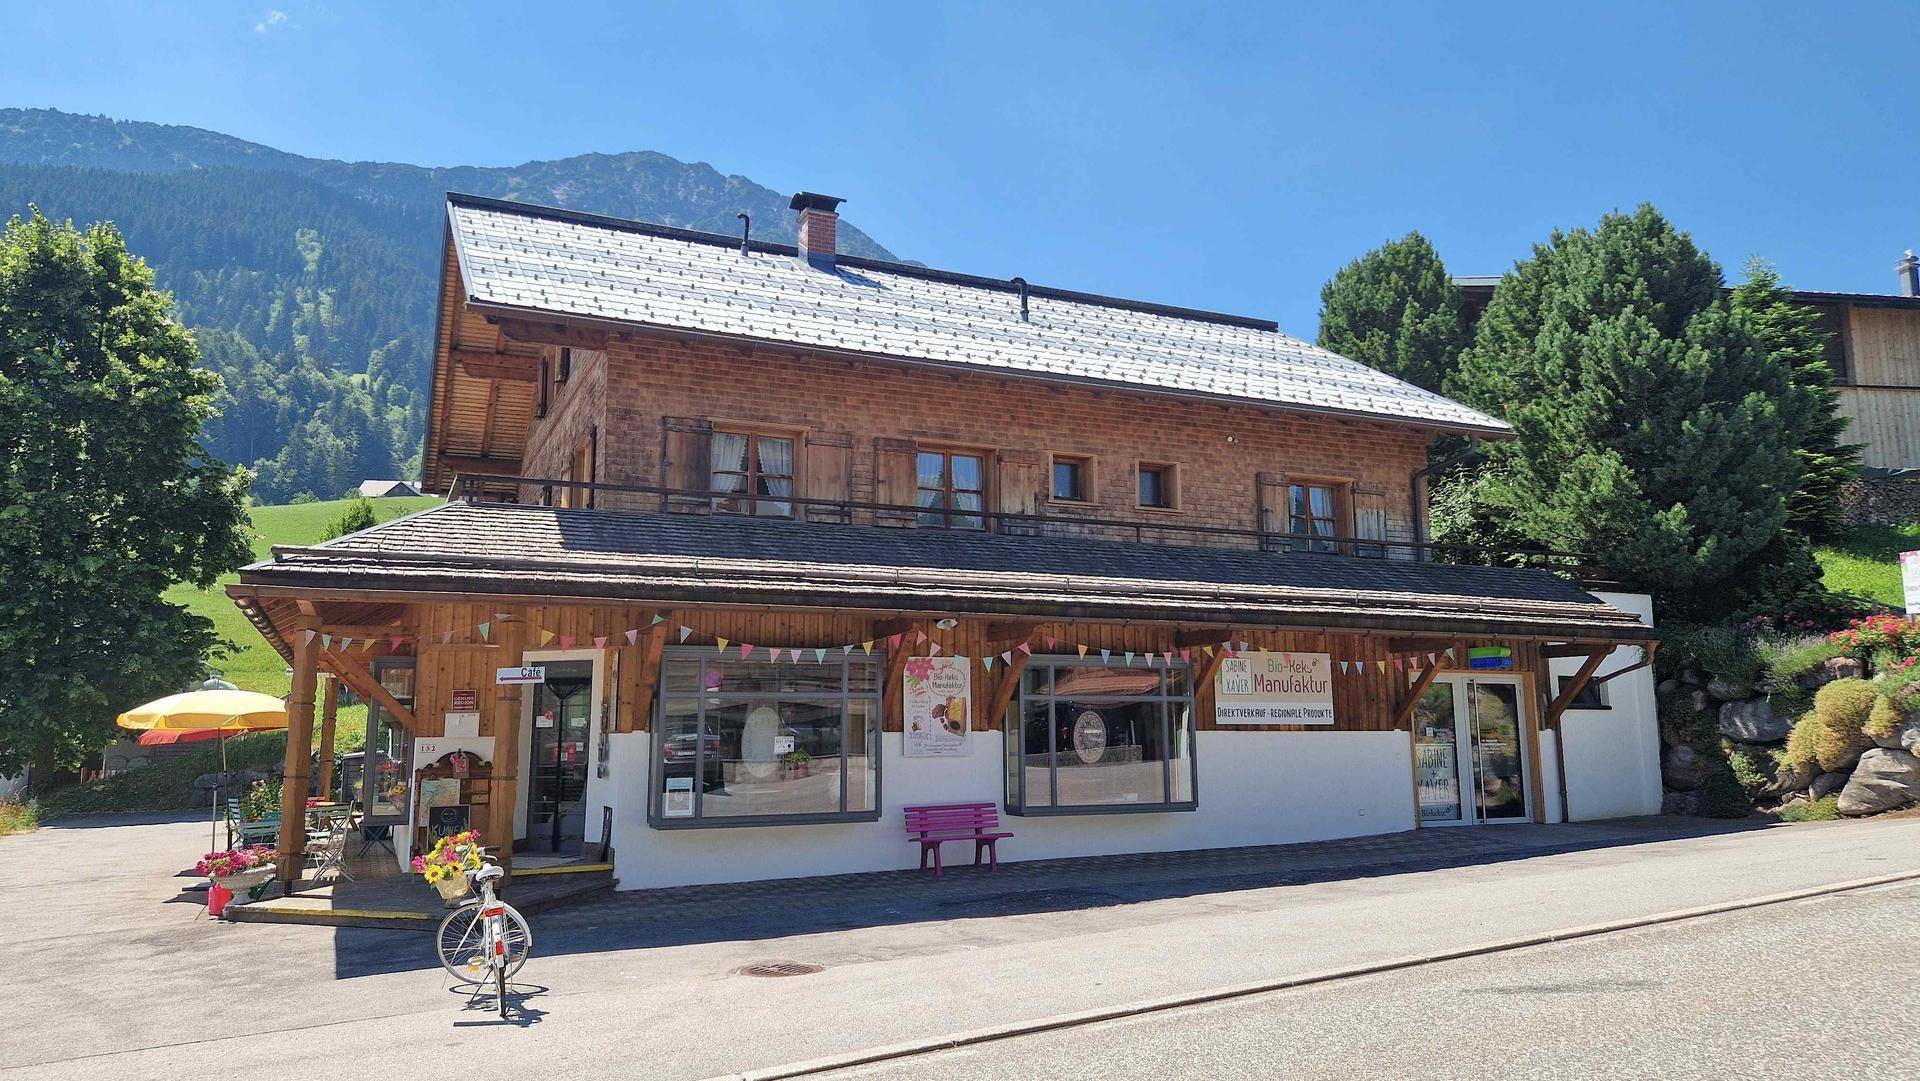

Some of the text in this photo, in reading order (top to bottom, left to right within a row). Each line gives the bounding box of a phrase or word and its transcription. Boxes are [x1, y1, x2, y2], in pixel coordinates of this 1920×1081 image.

[521, 667, 541, 677] Café
[1225, 659, 1247, 673] SABINE
[1267, 658, 1312, 673] Bio-Keks
[1226, 679, 1249, 693] XAVER
[1254, 673, 1328, 693] Manufaktur
[1416, 748, 1448, 769] SABINE
